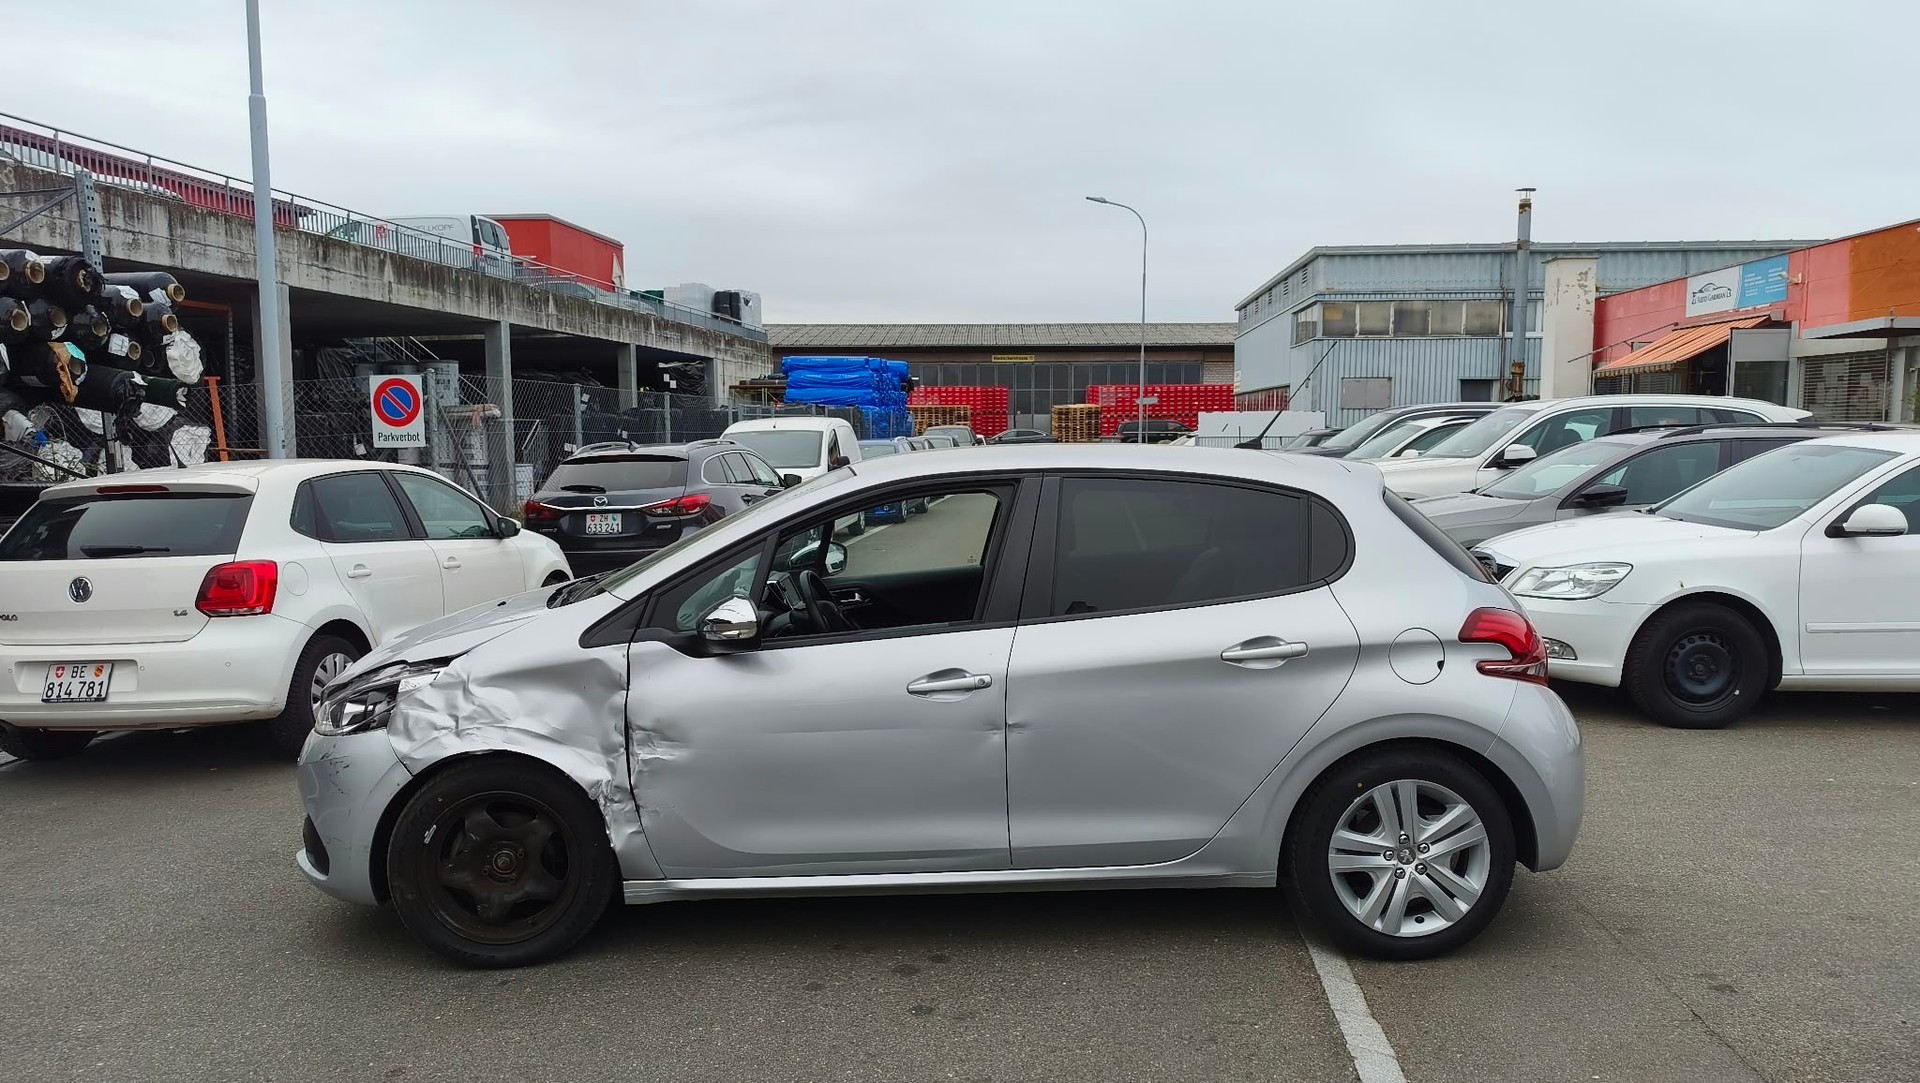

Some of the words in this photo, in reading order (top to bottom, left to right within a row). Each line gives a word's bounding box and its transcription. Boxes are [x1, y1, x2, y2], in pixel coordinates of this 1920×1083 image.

[378, 432, 420, 442] Parkverbot
[600, 515, 609, 523] ZH
[587, 523, 603, 533] 633
[604, 523, 620, 533] 241
[71, 665, 88, 678] BE
[45, 681, 73, 698] 814
[77, 680, 104, 698] 781
